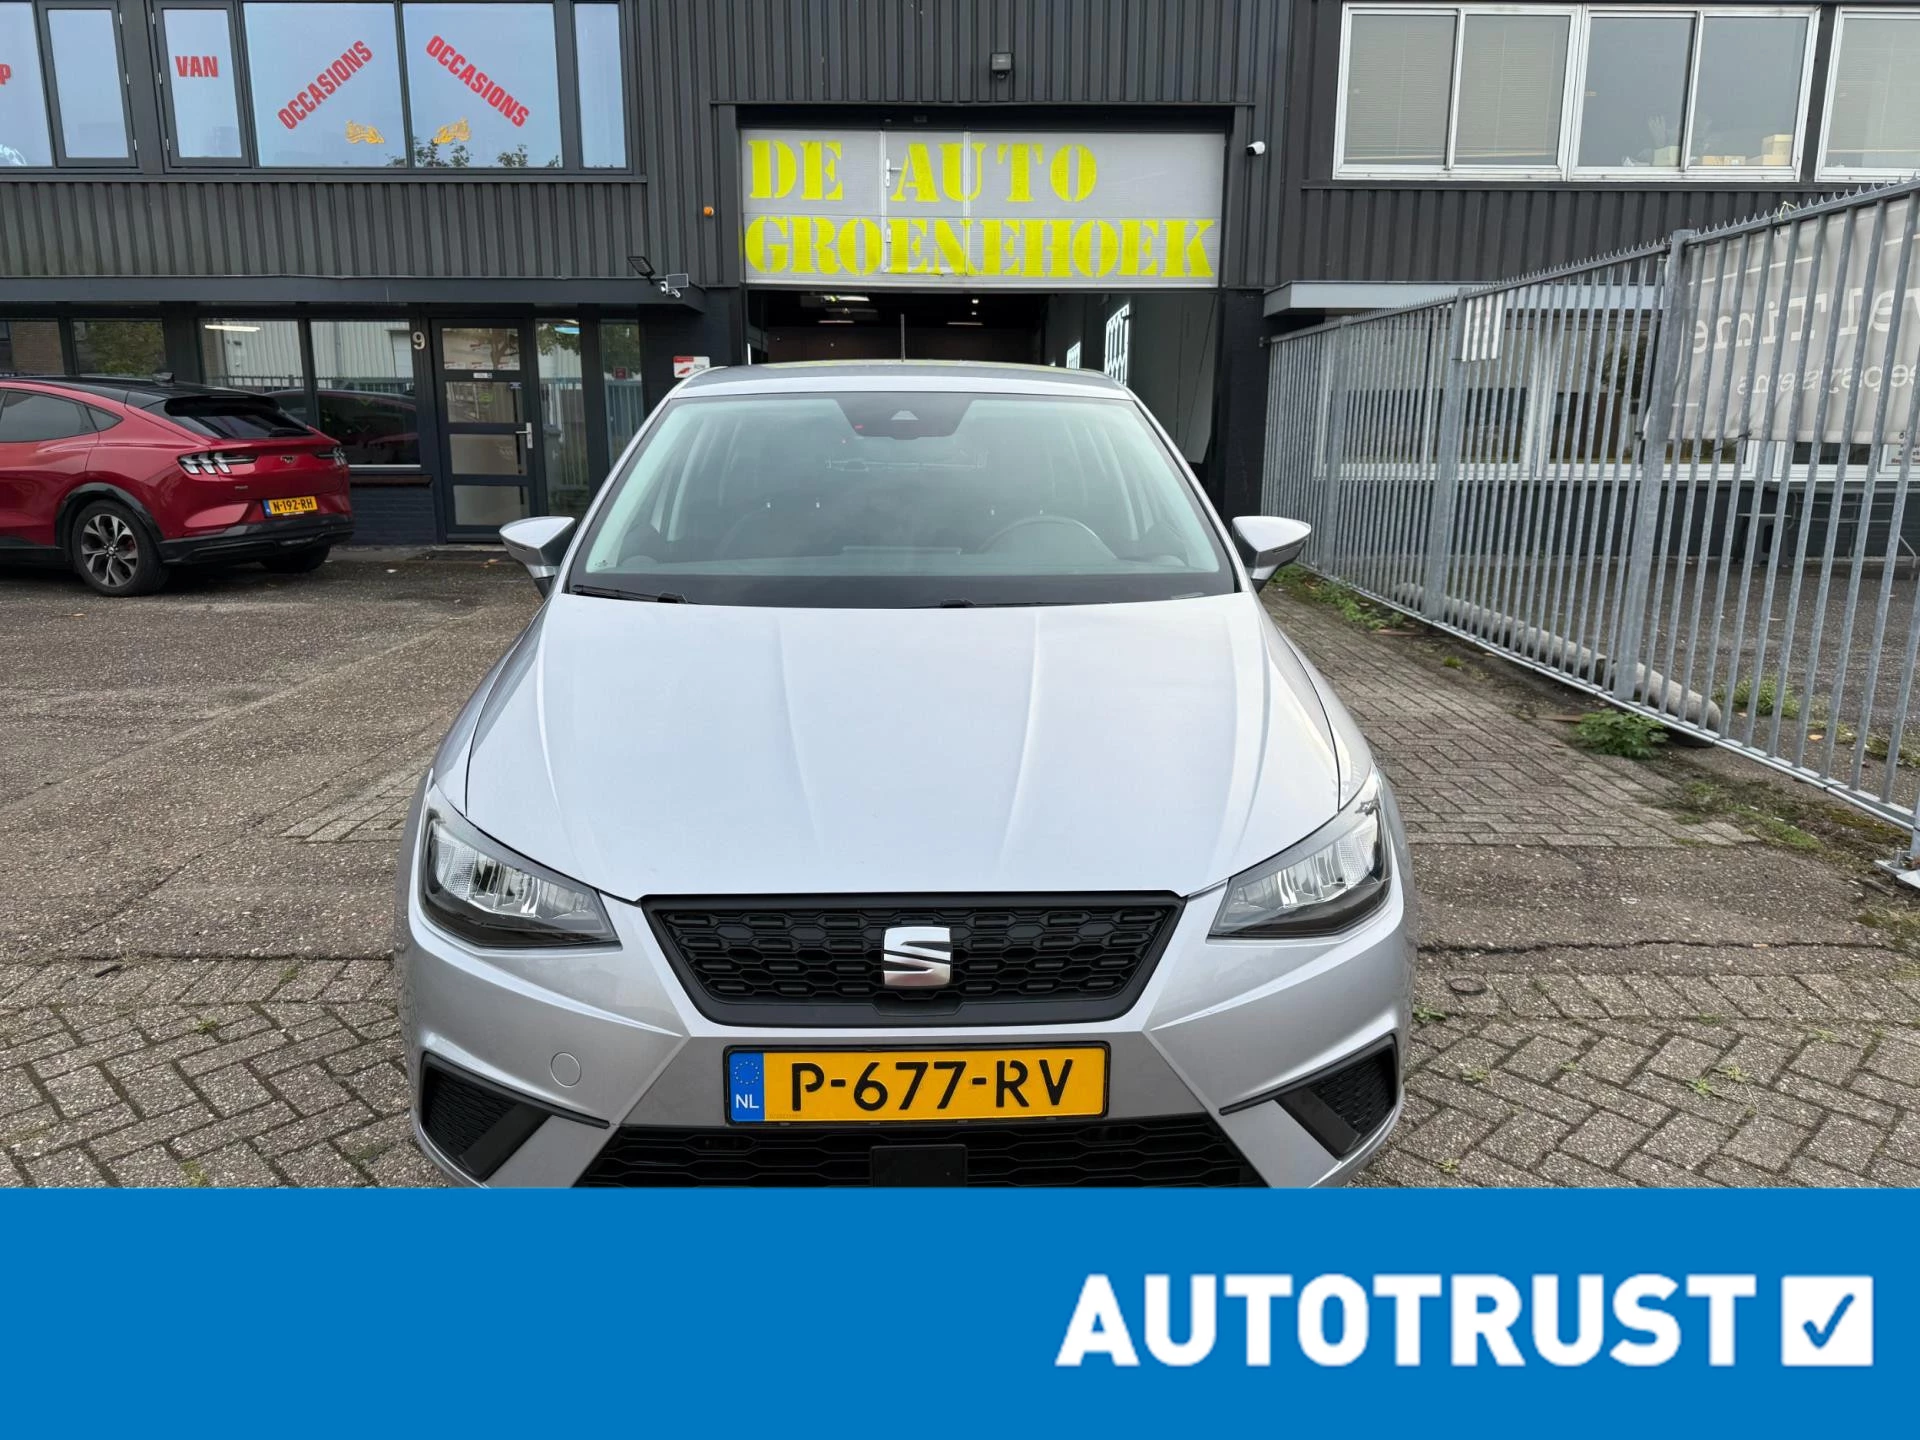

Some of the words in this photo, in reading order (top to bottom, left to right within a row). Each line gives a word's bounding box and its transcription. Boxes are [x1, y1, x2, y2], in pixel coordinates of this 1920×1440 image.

[176, 56, 218, 77] VAN
[279, 42, 372, 129] OCCASIONS
[427, 36, 529, 127] OCCASIONS
[748, 140, 842, 200] DE
[891, 143, 1096, 203] AUTO
[745, 216, 1214, 278] GROENEHOEK
[412, 331, 425, 350] 9
[272, 498, 314, 512] N-192-RH
[735, 1094, 758, 1108] NL
[791, 1059, 1073, 1112] P-677-RV
